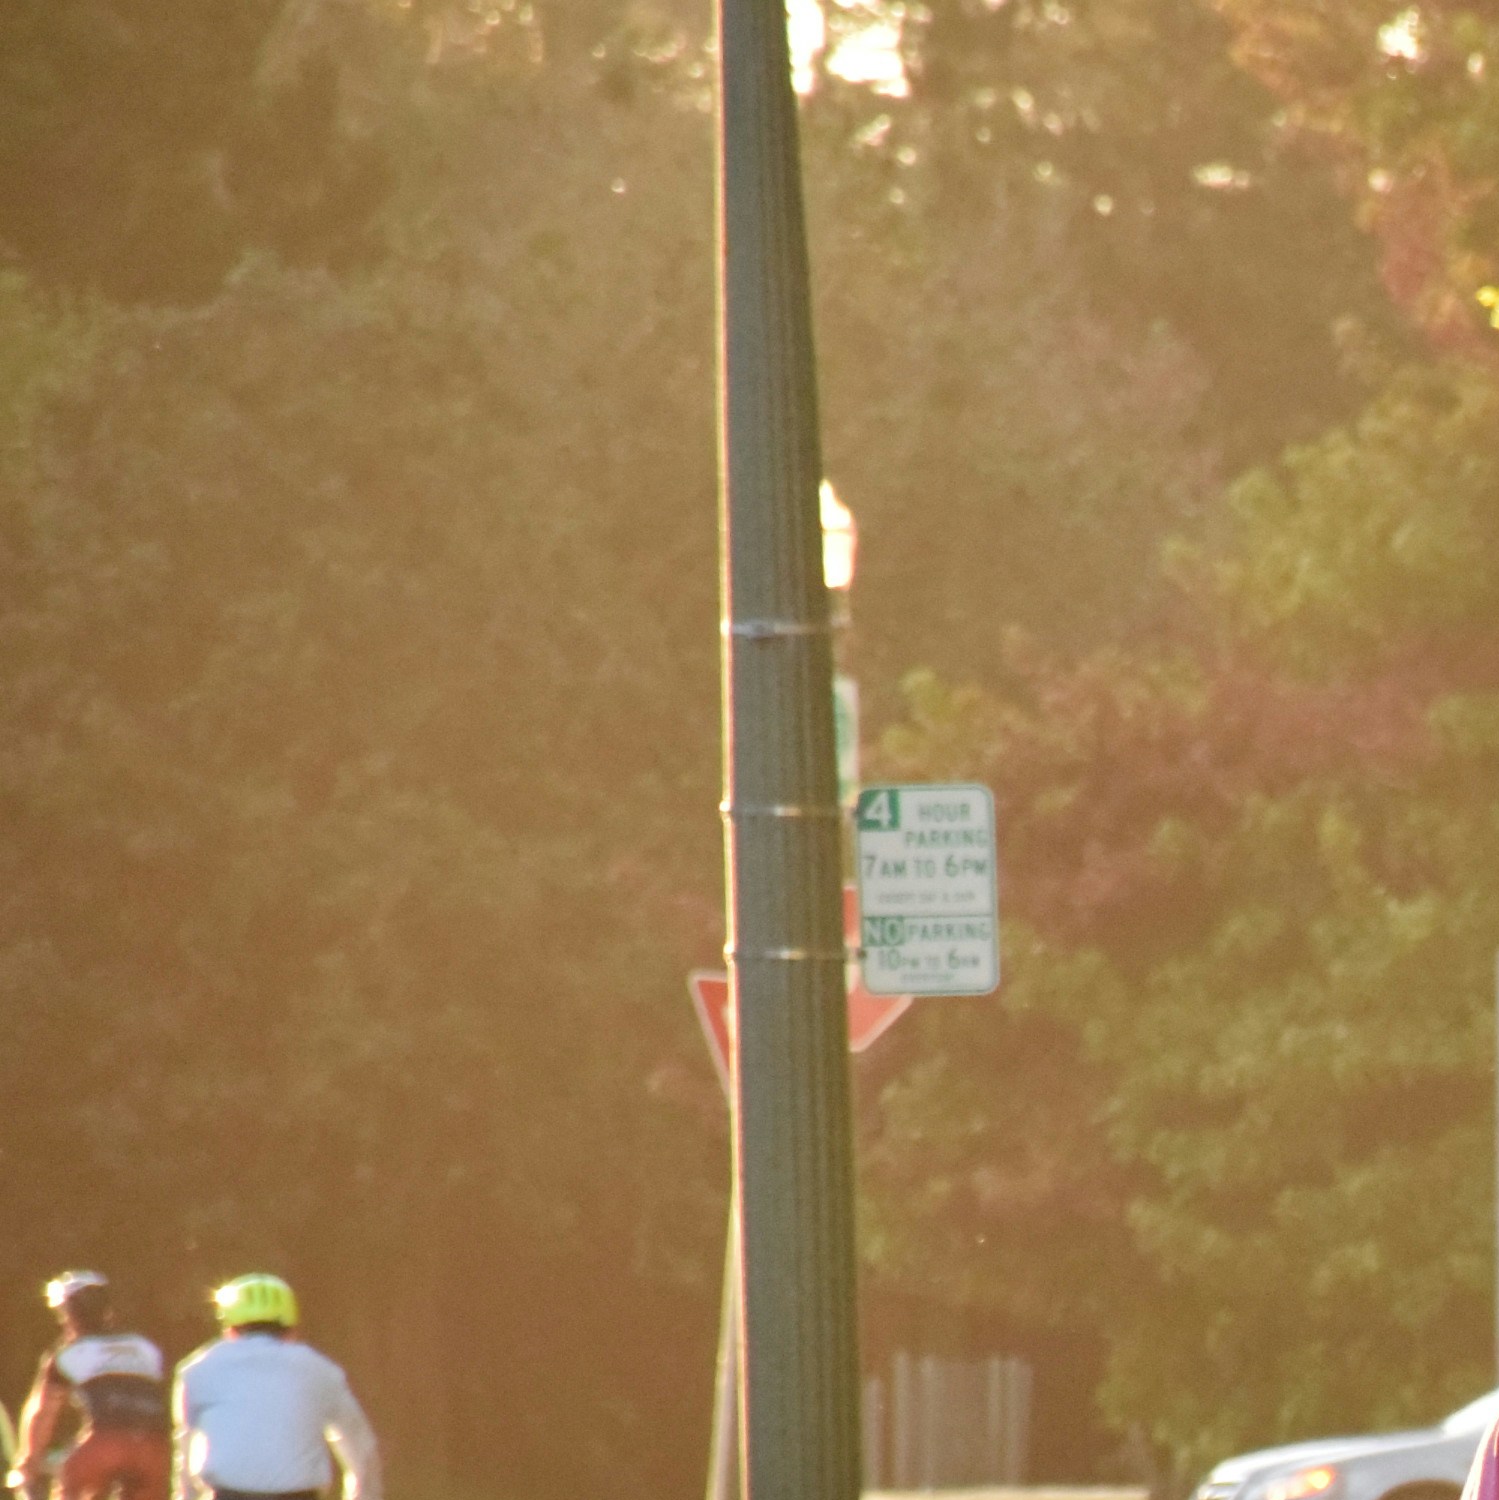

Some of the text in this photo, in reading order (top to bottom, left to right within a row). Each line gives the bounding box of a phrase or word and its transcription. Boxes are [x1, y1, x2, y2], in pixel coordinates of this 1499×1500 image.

[866, 793, 970, 829] 4 HOUR
[905, 830, 990, 847] PARKING
[913, 858, 936, 878] TO
[864, 918, 992, 945] NO PARKING
